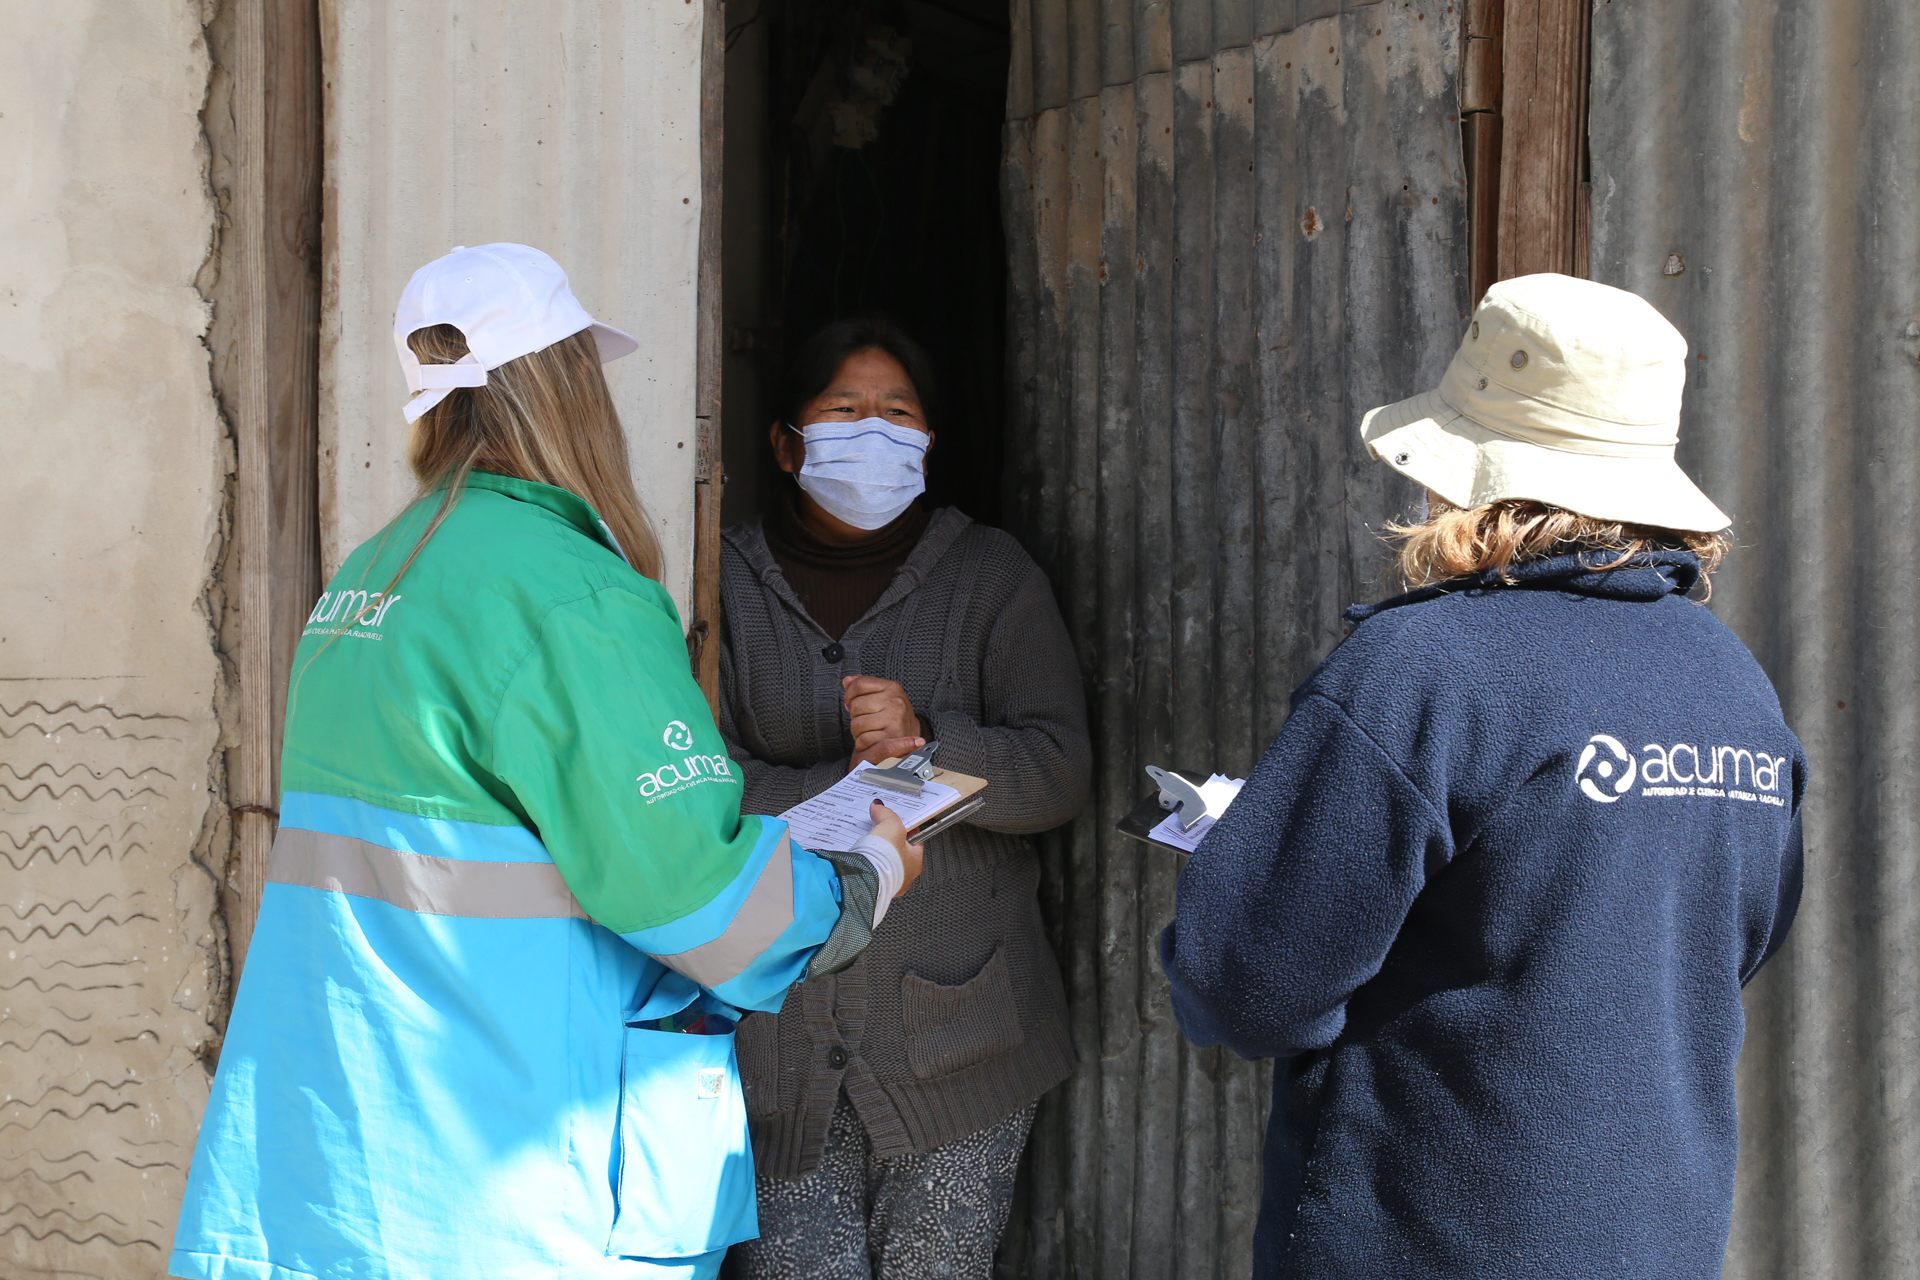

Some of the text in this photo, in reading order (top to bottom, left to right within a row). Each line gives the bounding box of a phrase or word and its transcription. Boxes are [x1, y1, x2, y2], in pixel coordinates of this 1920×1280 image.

[305, 590, 402, 627] cumar
[1642, 743, 1786, 791] acumar
[1642, 786, 1688, 797] AUTORIDAD
[1696, 786, 1726, 797] CUENCA
